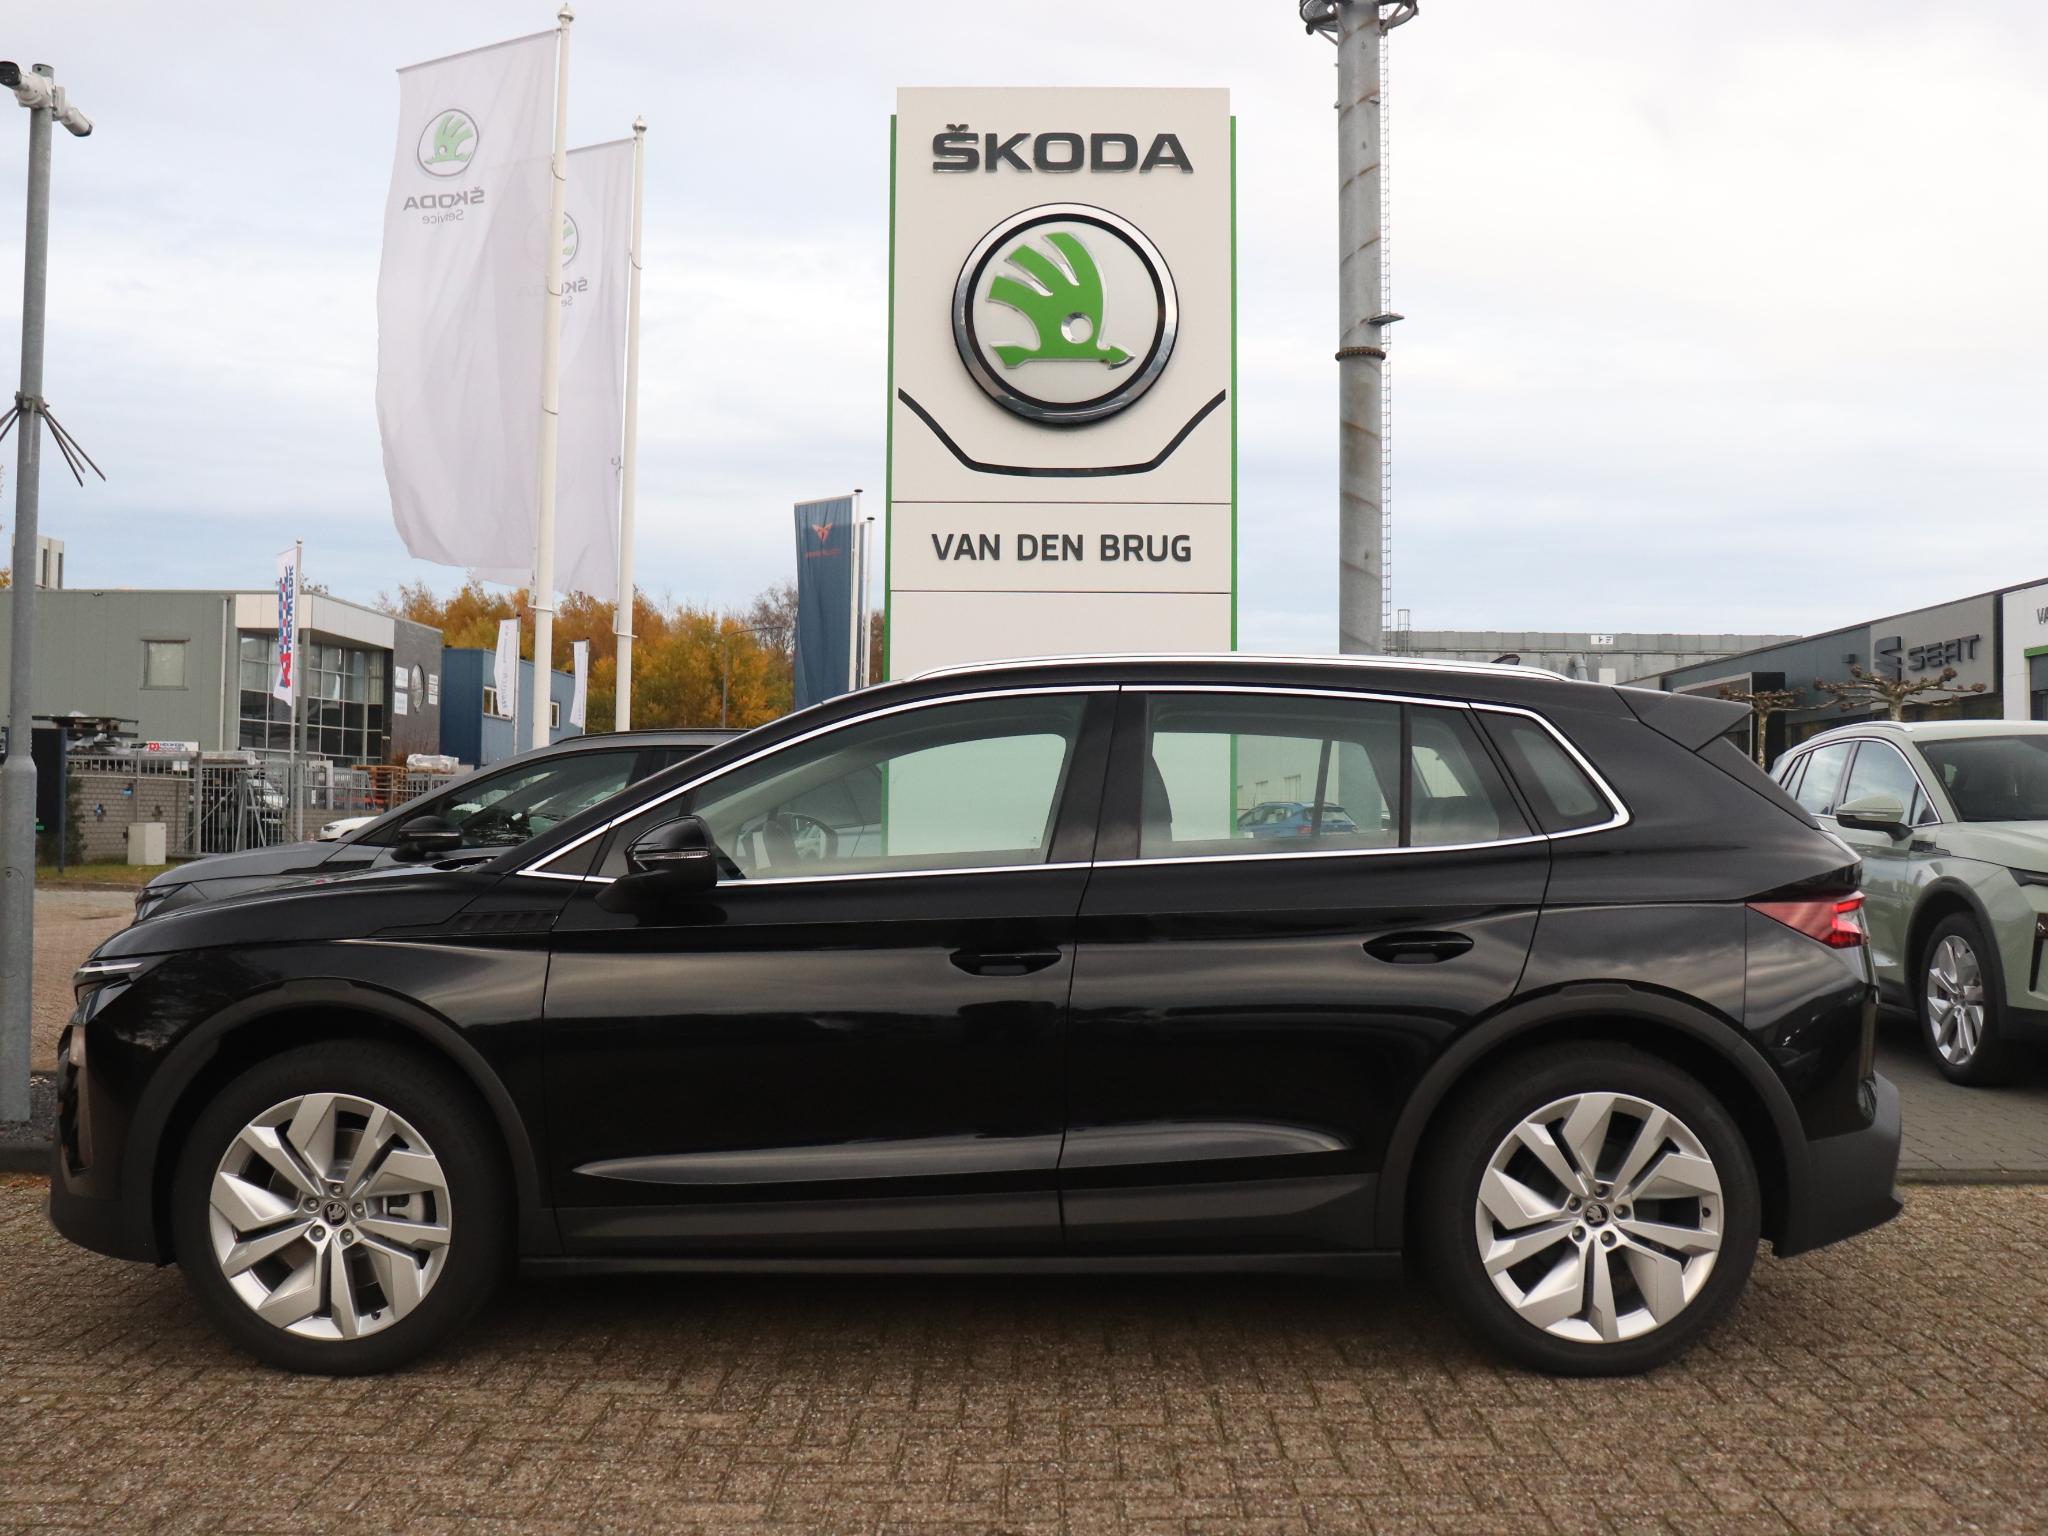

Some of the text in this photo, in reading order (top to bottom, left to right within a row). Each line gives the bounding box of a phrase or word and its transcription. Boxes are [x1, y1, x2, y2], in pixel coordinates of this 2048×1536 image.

[933, 124, 1194, 174] ŠKODA
[931, 534, 1192, 562] VAN DEN BRUG
[1908, 634, 1981, 671] SEAT
